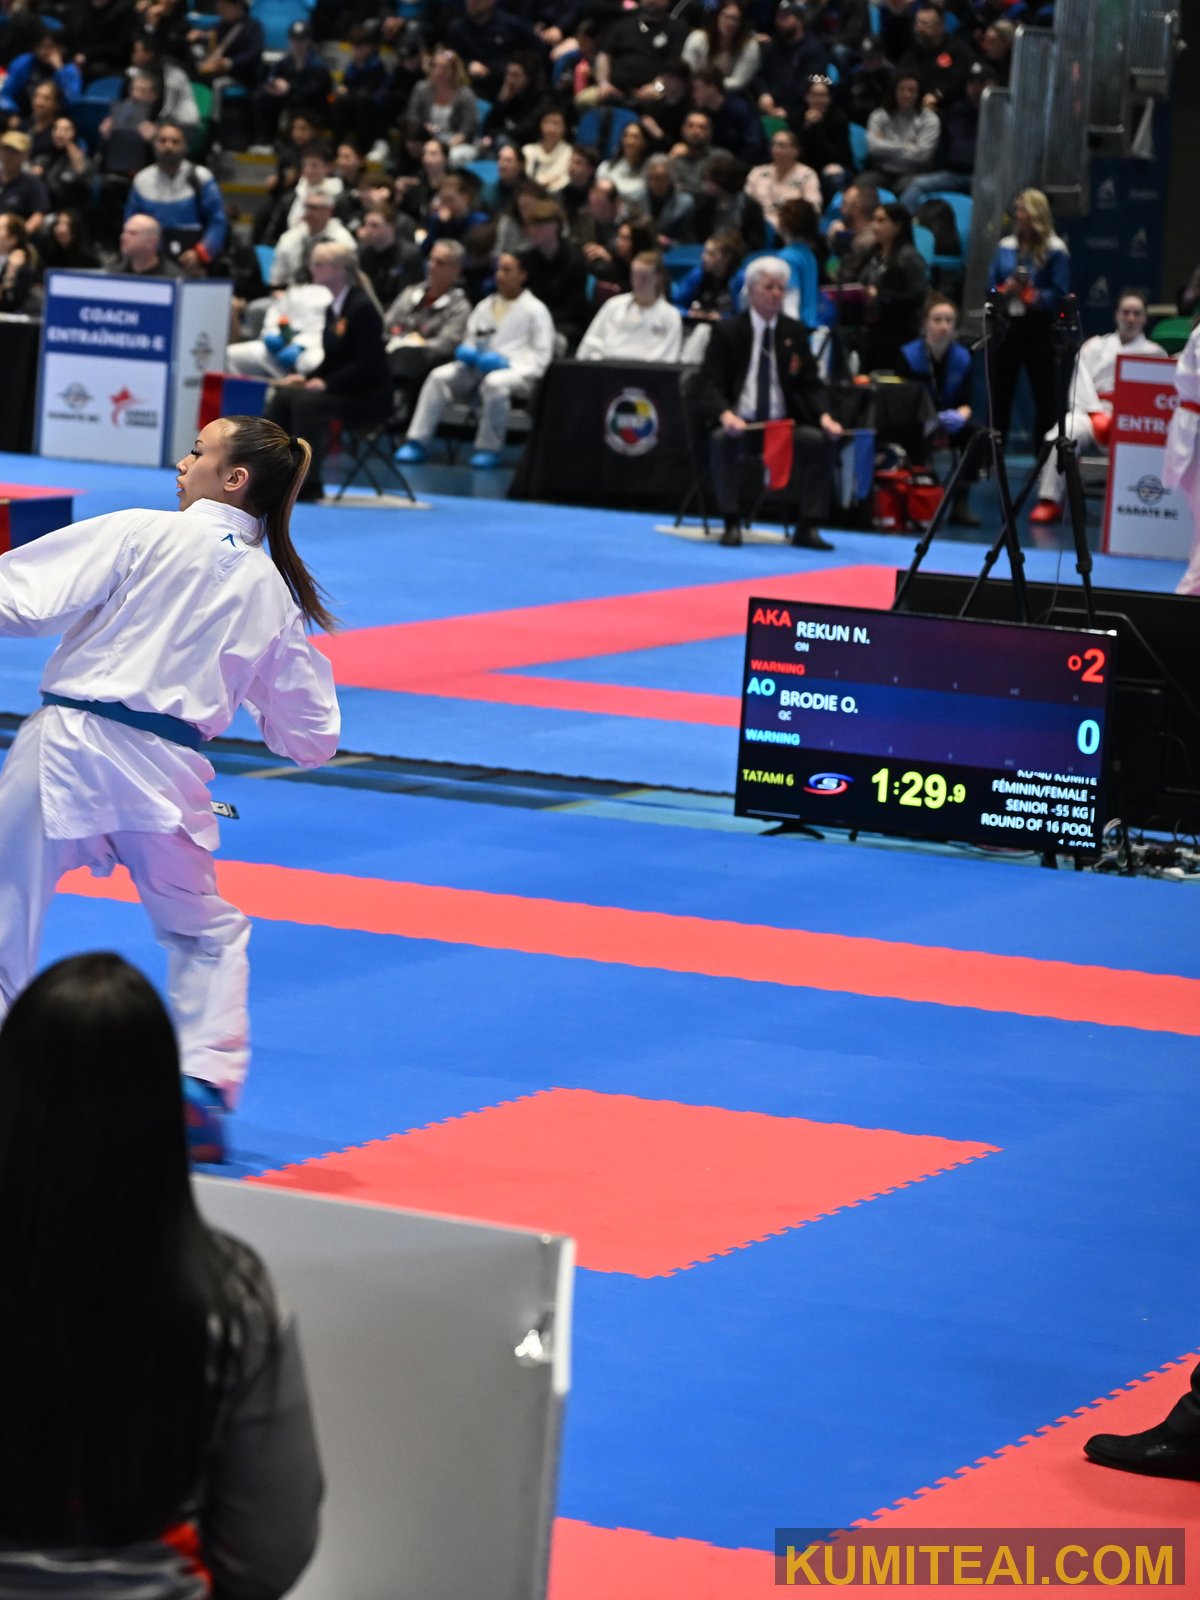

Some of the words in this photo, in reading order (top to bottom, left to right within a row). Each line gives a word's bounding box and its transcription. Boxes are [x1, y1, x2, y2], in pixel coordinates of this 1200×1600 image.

[79, 307, 139, 326] COACH
[752, 608, 792, 627] AKA
[796, 621, 850, 642] REKUN
[853, 627, 870, 644] N.
[794, 641, 809, 652] ON
[751, 659, 805, 676] WARNING
[747, 677, 776, 697] AO
[780, 690, 838, 711] BRODIE
[841, 696, 858, 714] O.
[778, 710, 792, 721] QC
[745, 728, 800, 746] WARNING
[1077, 719, 1101, 755] 0
[743, 769, 784, 785] TATAMI
[785, 773, 794, 786] 6
[871, 768, 966, 809] 1:29.9
[992, 778, 1088, 802] FÉMININ/FEMALE
[1005, 798, 1048, 815] SENIOR
[1051, 804, 1069, 818] -55
[1072, 806, 1089, 820] KG
[981, 812, 1025, 830] ROUND
[1026, 817, 1043, 831] OF
[1046, 820, 1060, 834] 16
[1061, 821, 1094, 838] POOL
